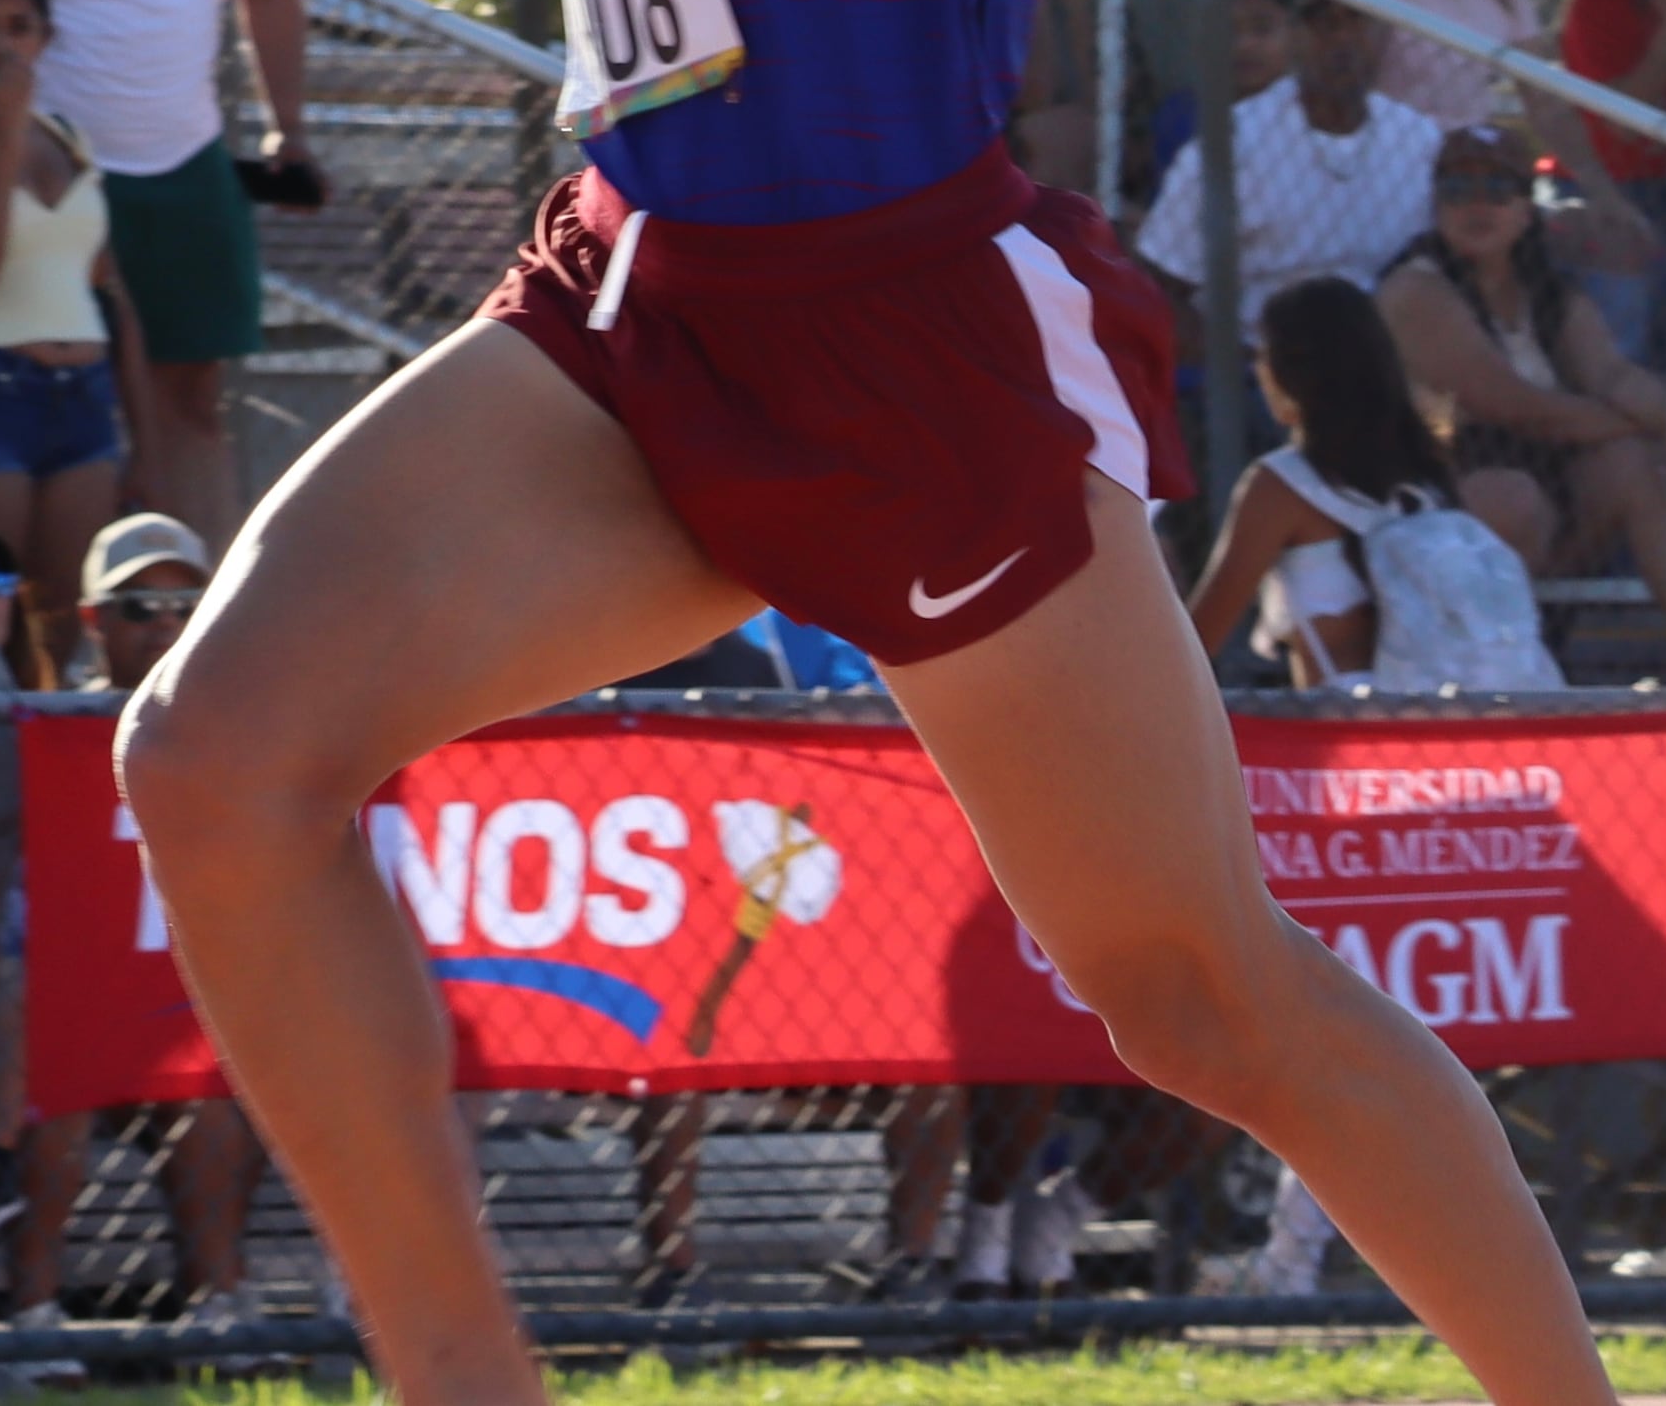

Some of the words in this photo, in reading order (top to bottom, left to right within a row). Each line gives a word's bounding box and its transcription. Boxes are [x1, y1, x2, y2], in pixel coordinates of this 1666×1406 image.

[1242, 765, 1564, 816] UNIVERSIDAD
[1256, 830, 1326, 880] NA
[1379, 816, 1582, 876] MÉNDEZ
